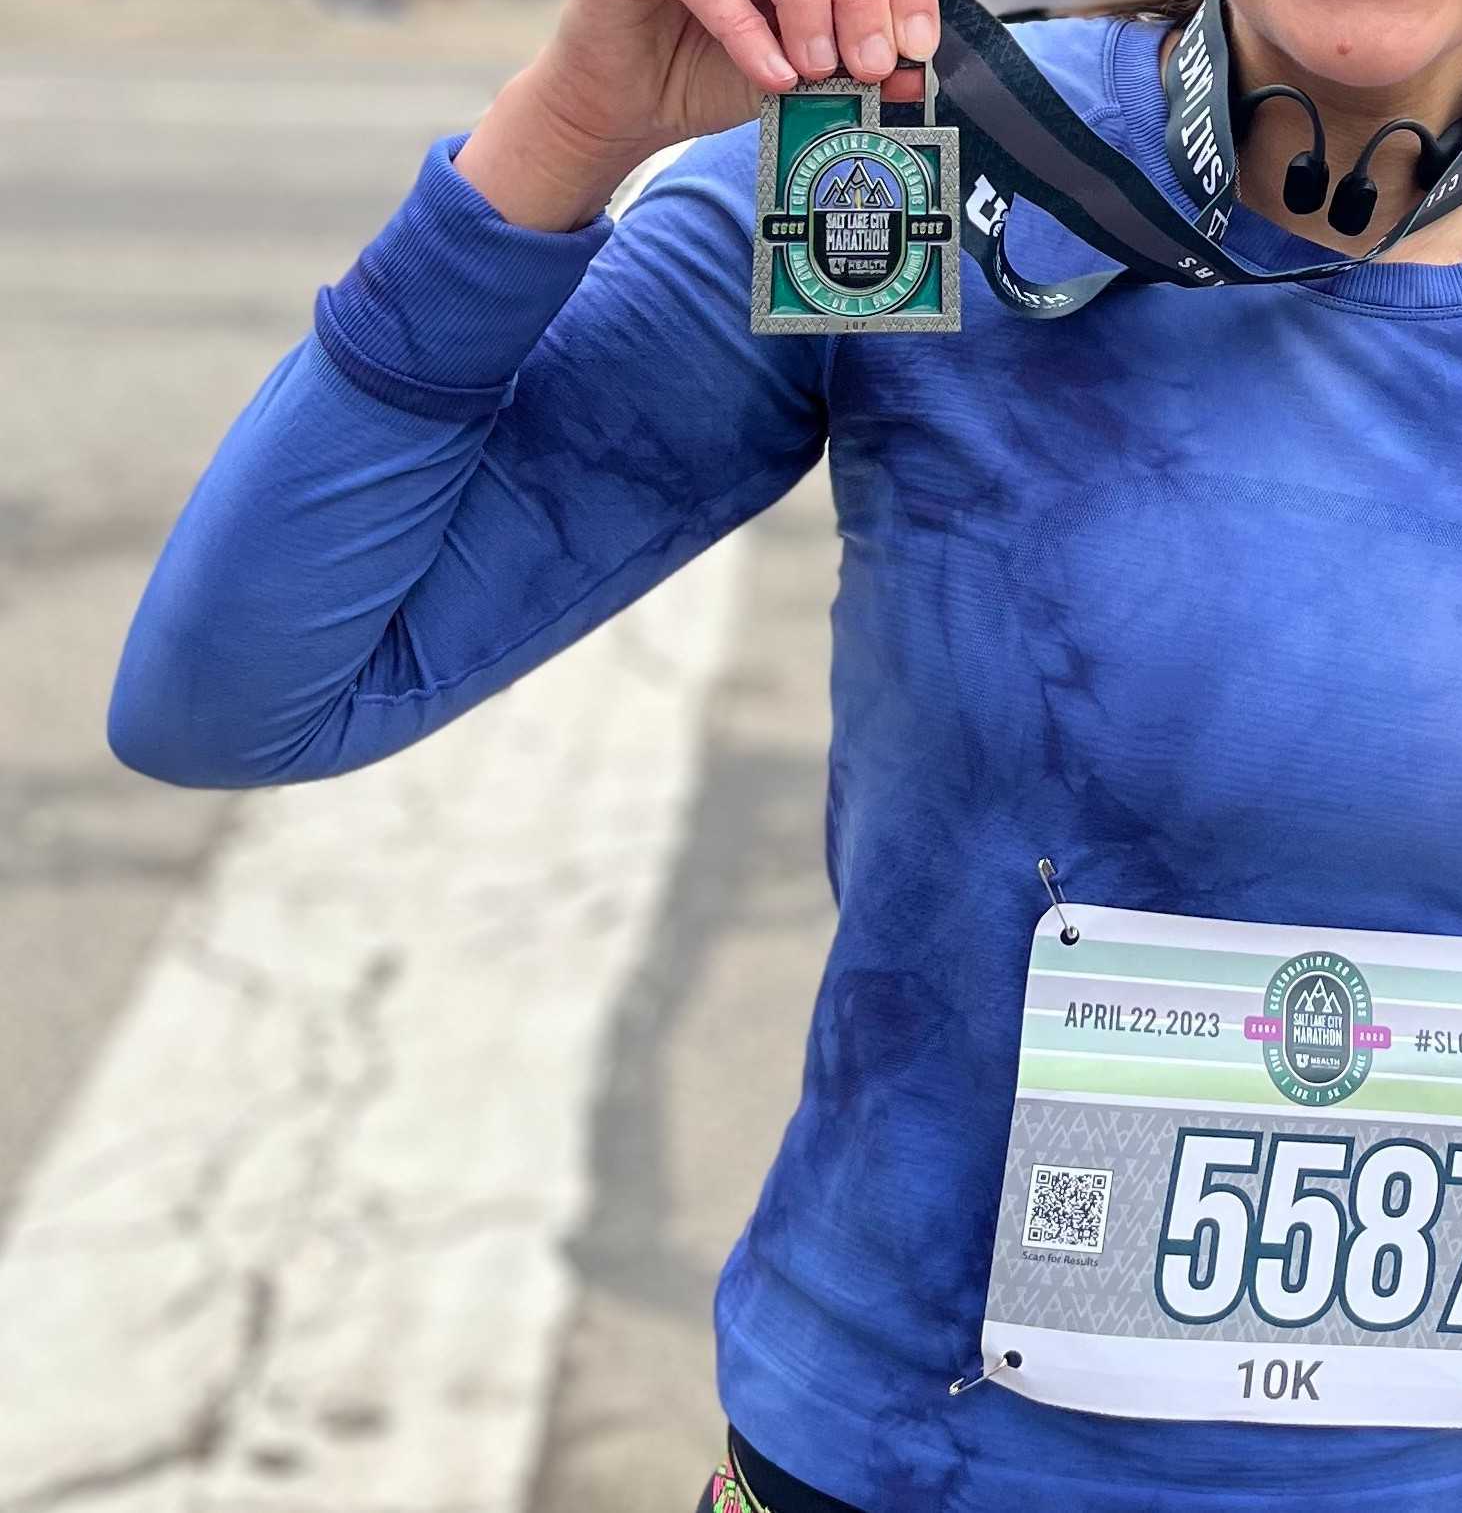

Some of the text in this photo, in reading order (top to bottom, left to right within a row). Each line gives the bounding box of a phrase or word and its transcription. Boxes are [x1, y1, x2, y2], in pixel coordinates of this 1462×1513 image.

[1178, 29, 1215, 120] LAKE
[1181, 105, 1224, 197] SALT
[826, 212, 890, 229] SALT LAKE CITY
[826, 228, 889, 251] MARATHON
[848, 259, 888, 270] HEALTH
[1270, 956, 1331, 1010] CELEBRATING
[1349, 977, 1367, 1017] YEARS
[1064, 1001, 1126, 1031] APRIL
[1293, 1013, 1343, 1029] SALT LAKE CITY
[1293, 1026, 1343, 1047] MARATHON
[1310, 1056, 1341, 1067] HEALTH
[1022, 1251, 1099, 1267] Scan for Results
[1237, 1359, 1324, 1400] 10K
